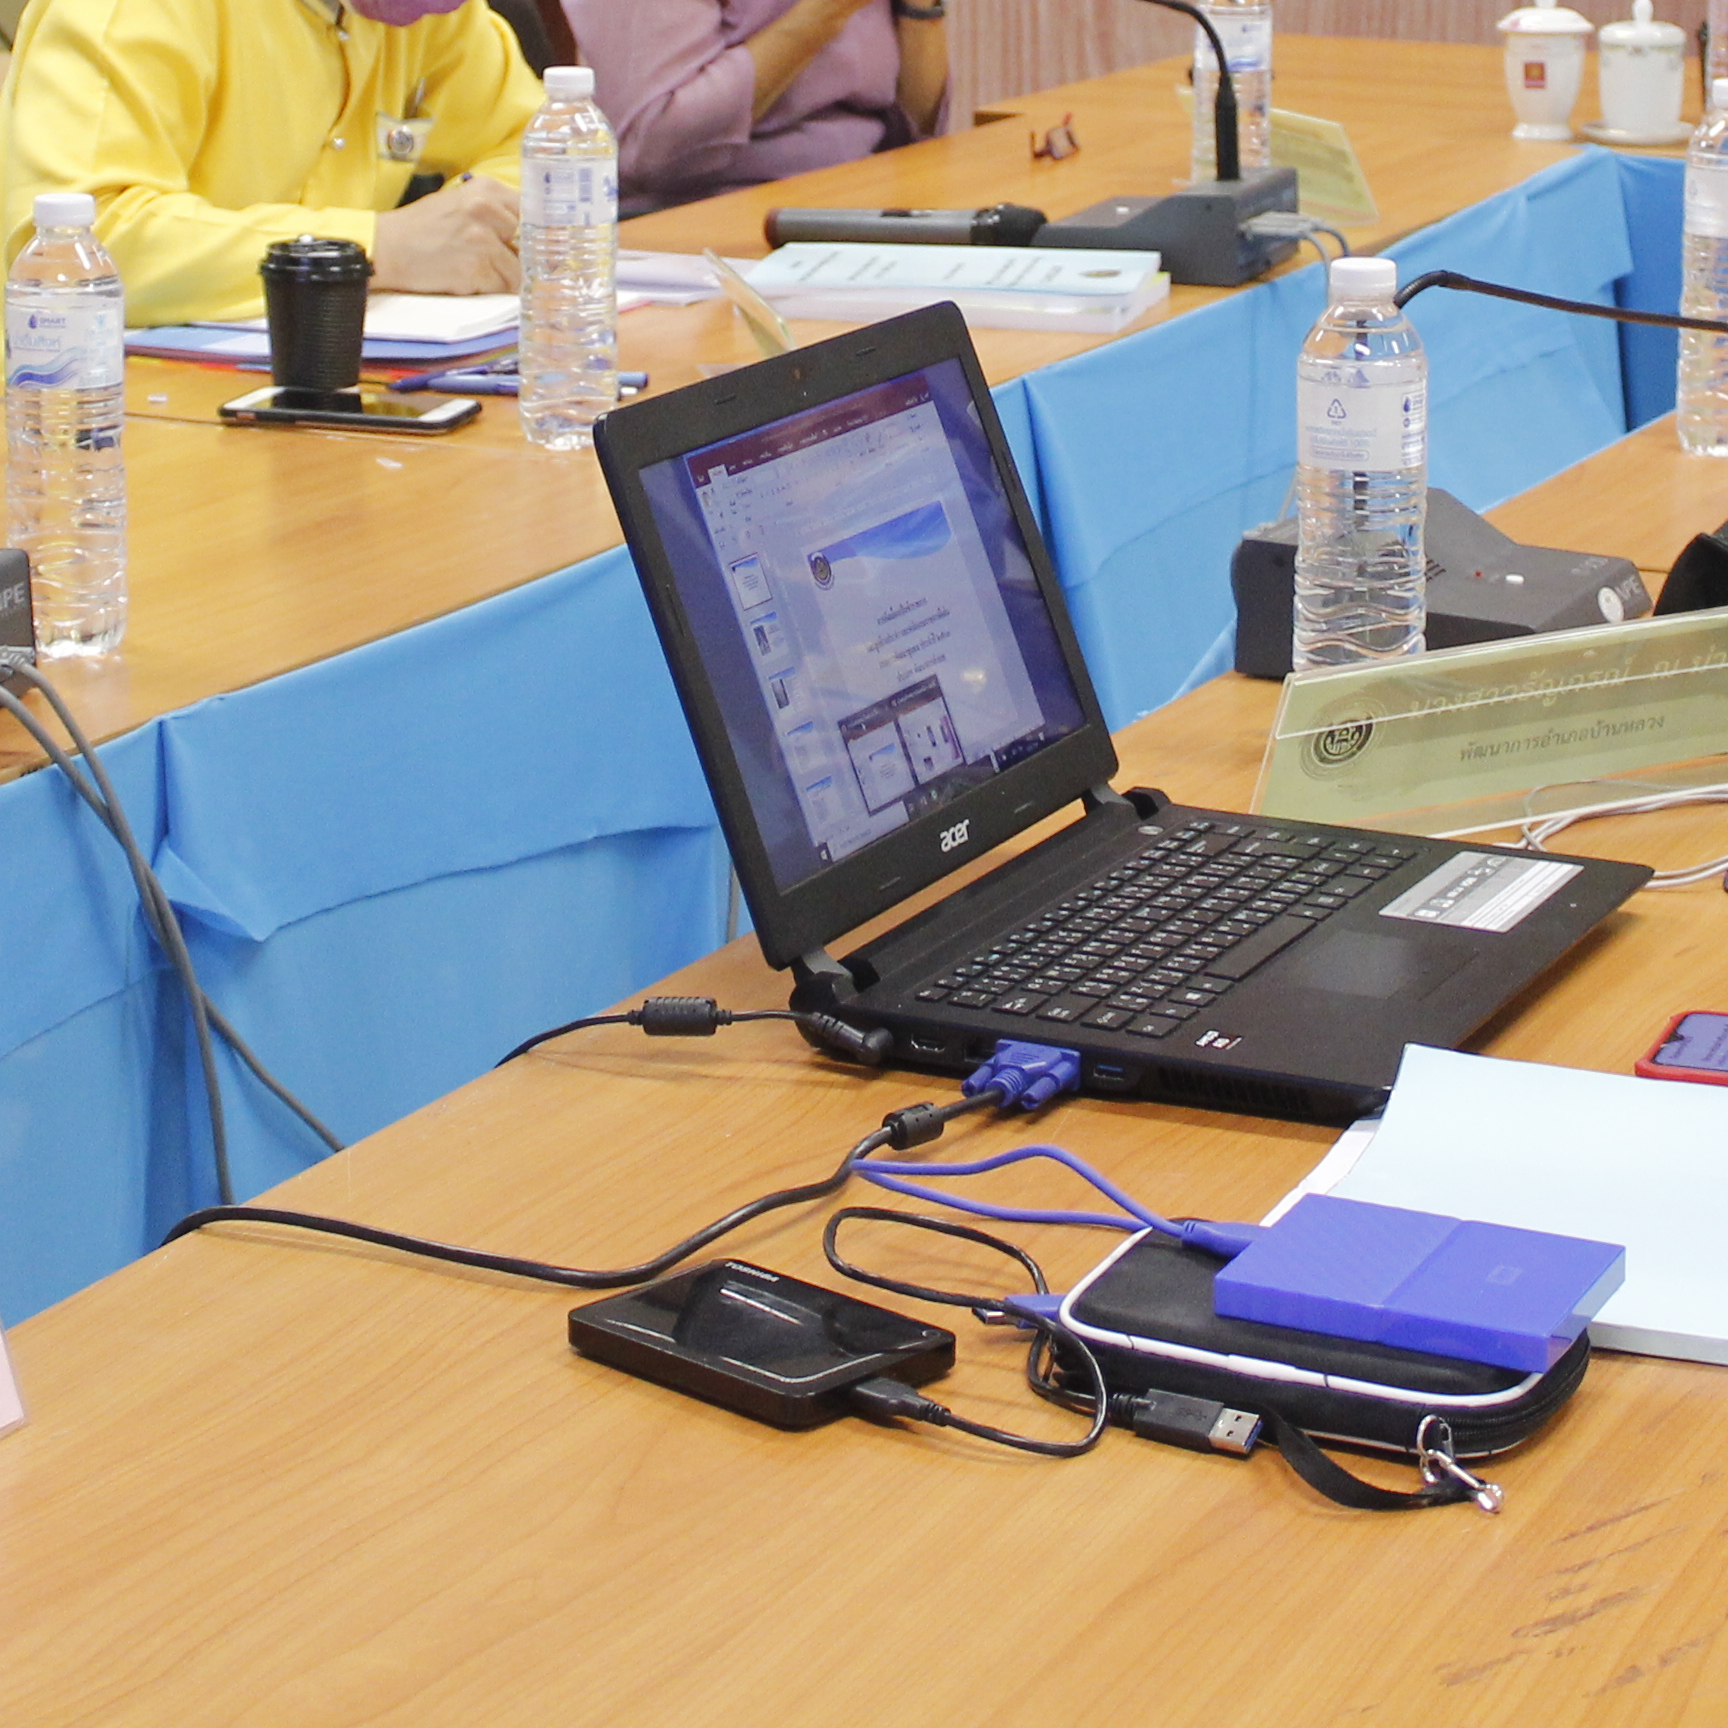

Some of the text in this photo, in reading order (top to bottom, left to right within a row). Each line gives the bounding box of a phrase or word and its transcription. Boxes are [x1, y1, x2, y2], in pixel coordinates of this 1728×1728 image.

[1459, 716, 1665, 762] พัฒนาการอำเภอบ้านหลวง
[939, 818, 970, 853] acer
